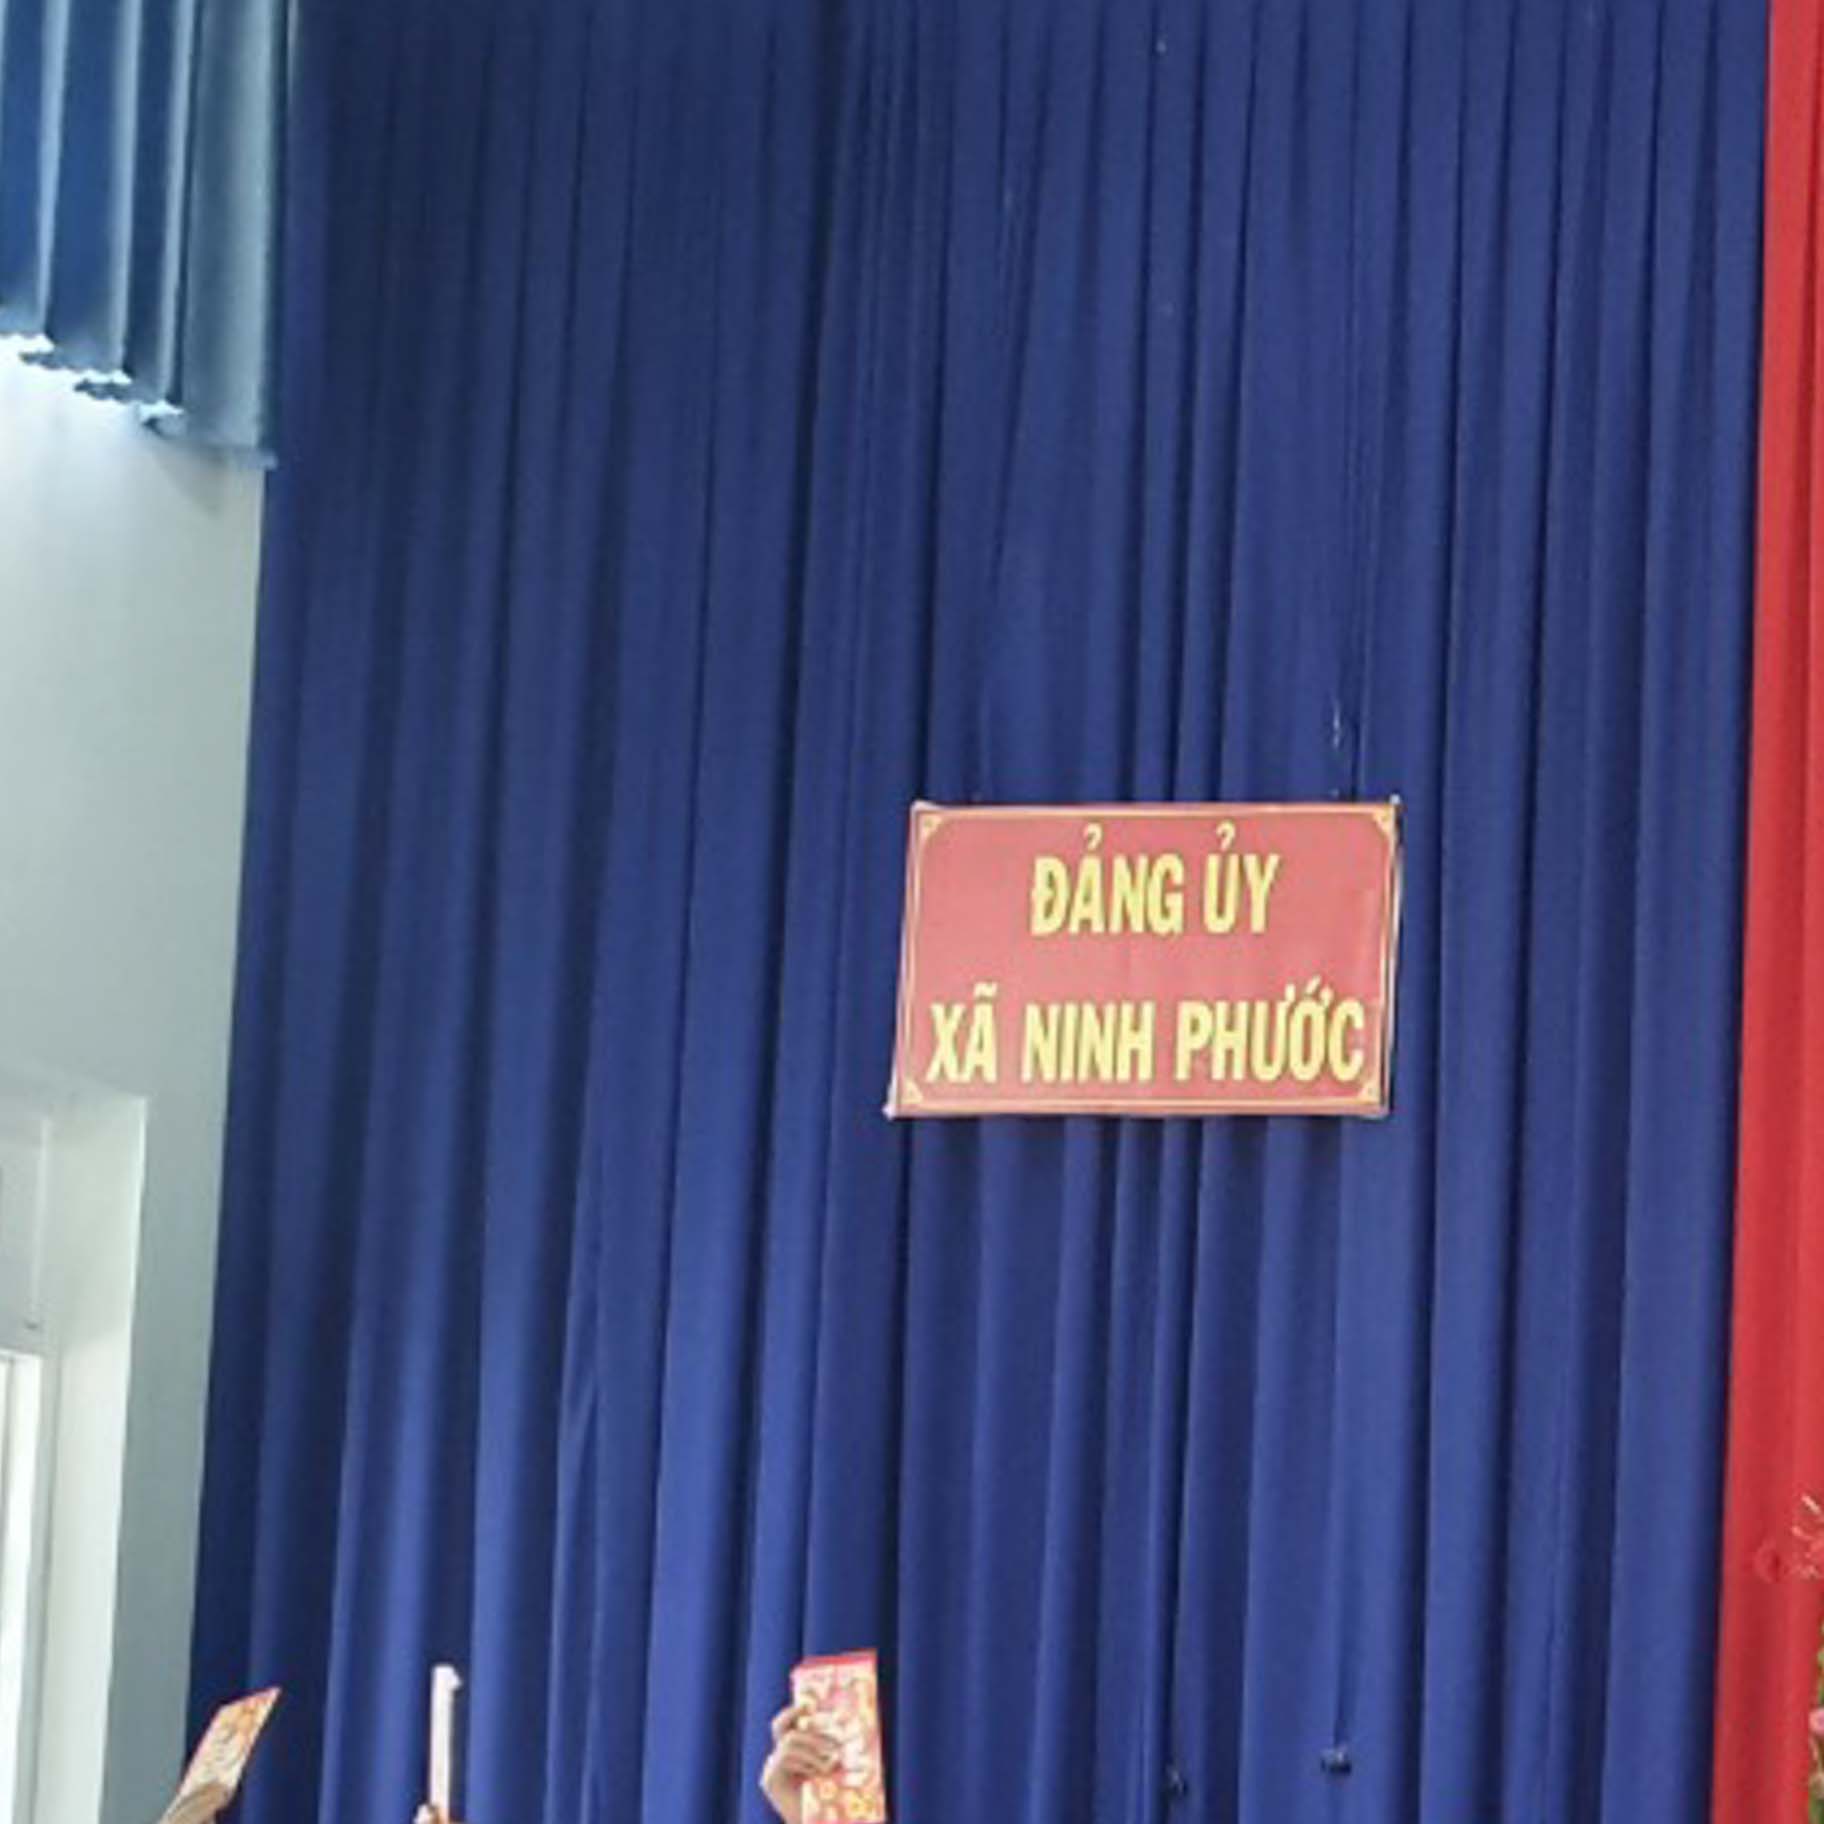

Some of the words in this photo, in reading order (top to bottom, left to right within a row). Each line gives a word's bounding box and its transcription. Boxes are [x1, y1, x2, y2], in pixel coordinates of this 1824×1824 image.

[1031, 823, 1184, 936] ĐẢNG
[1205, 820, 1280, 934] ỦY
[926, 982, 998, 1084] XÃ
[1021, 1002, 1154, 1084] NINH
[1174, 976, 1366, 1083] PHƯỚC
